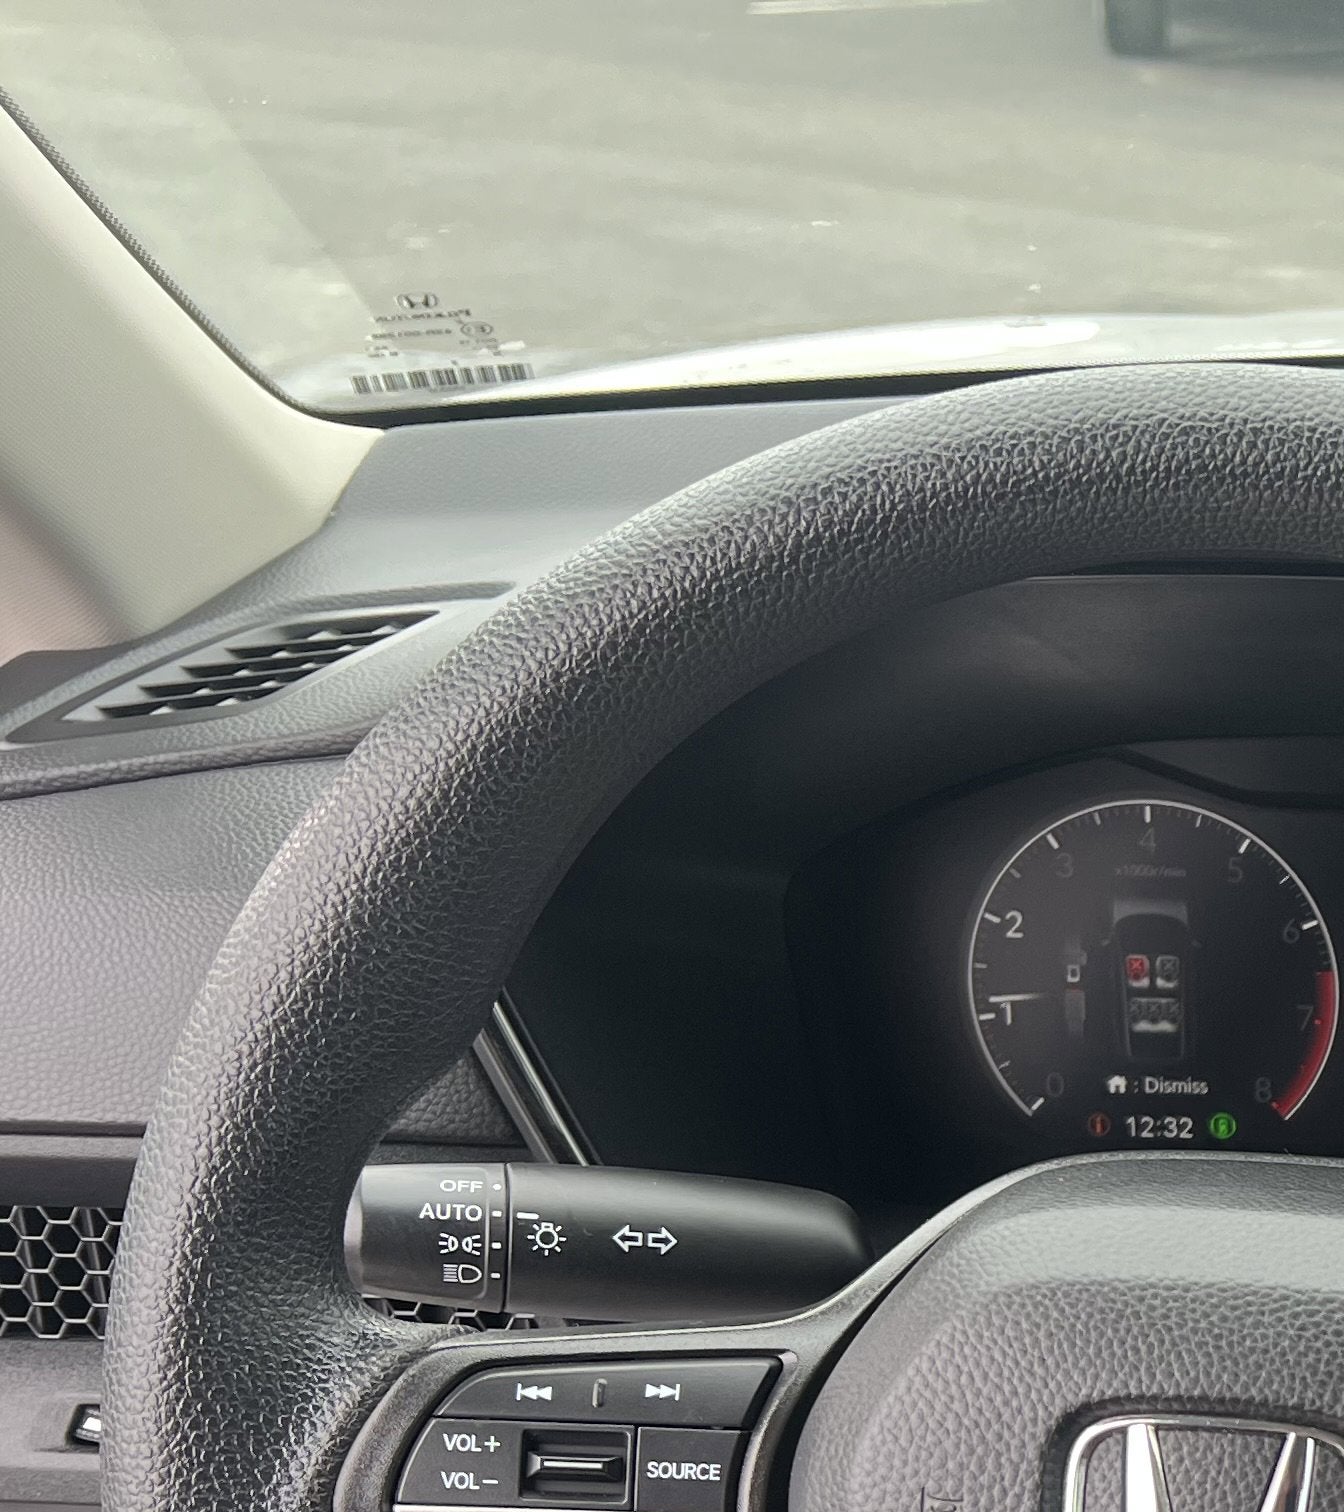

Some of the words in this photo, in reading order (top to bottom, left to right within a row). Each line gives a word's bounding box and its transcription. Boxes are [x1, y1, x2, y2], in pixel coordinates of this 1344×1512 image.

[1004, 911, 1024, 939] 2
[1144, 1075, 1208, 1096] Dismiss
[1126, 1116, 1194, 1139] 12:32
[439, 1180, 484, 1193] OFF
[419, 1202, 483, 1222] AUTO
[646, 1461, 722, 1481] SOURCE
